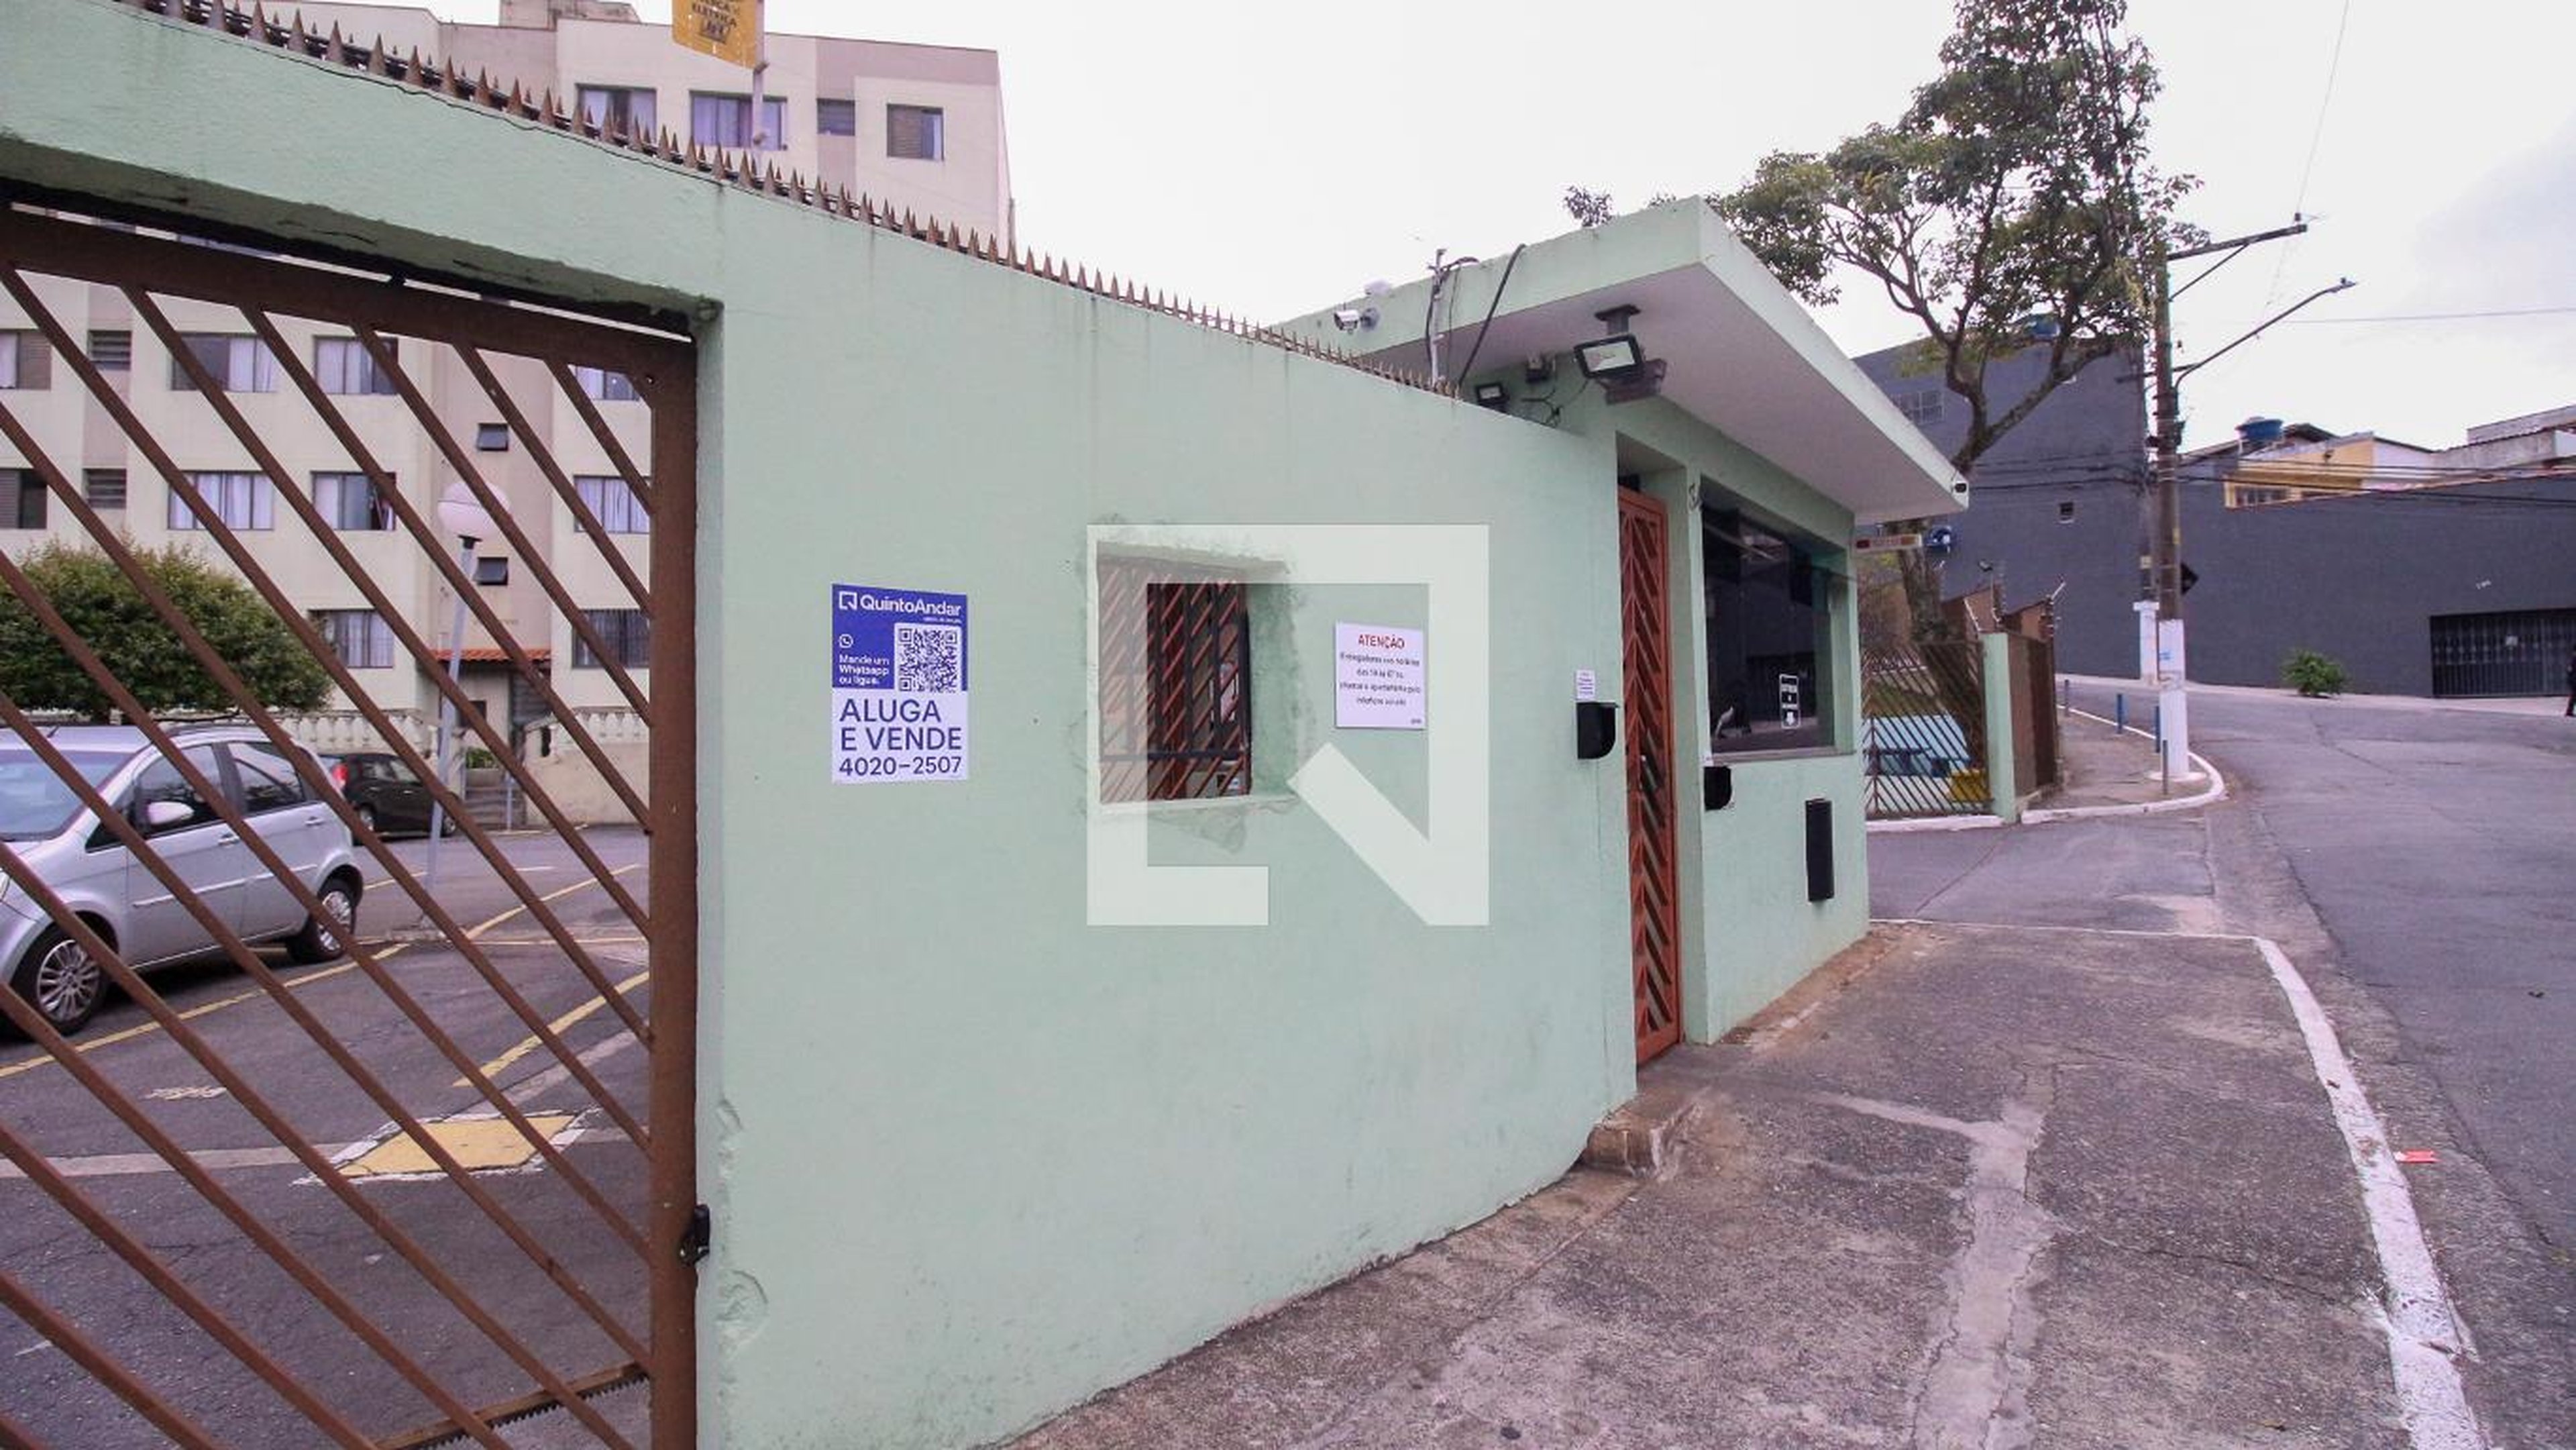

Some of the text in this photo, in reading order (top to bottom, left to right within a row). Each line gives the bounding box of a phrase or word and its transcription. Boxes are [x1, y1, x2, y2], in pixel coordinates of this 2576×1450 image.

[860, 594, 961, 616] QuintoAndar
[1358, 634, 1405, 649] ATENÇÃO
[839, 698, 941, 723] ALUGA
[841, 727, 962, 751] E VENDE
[839, 756, 962, 776] 4020-2507
